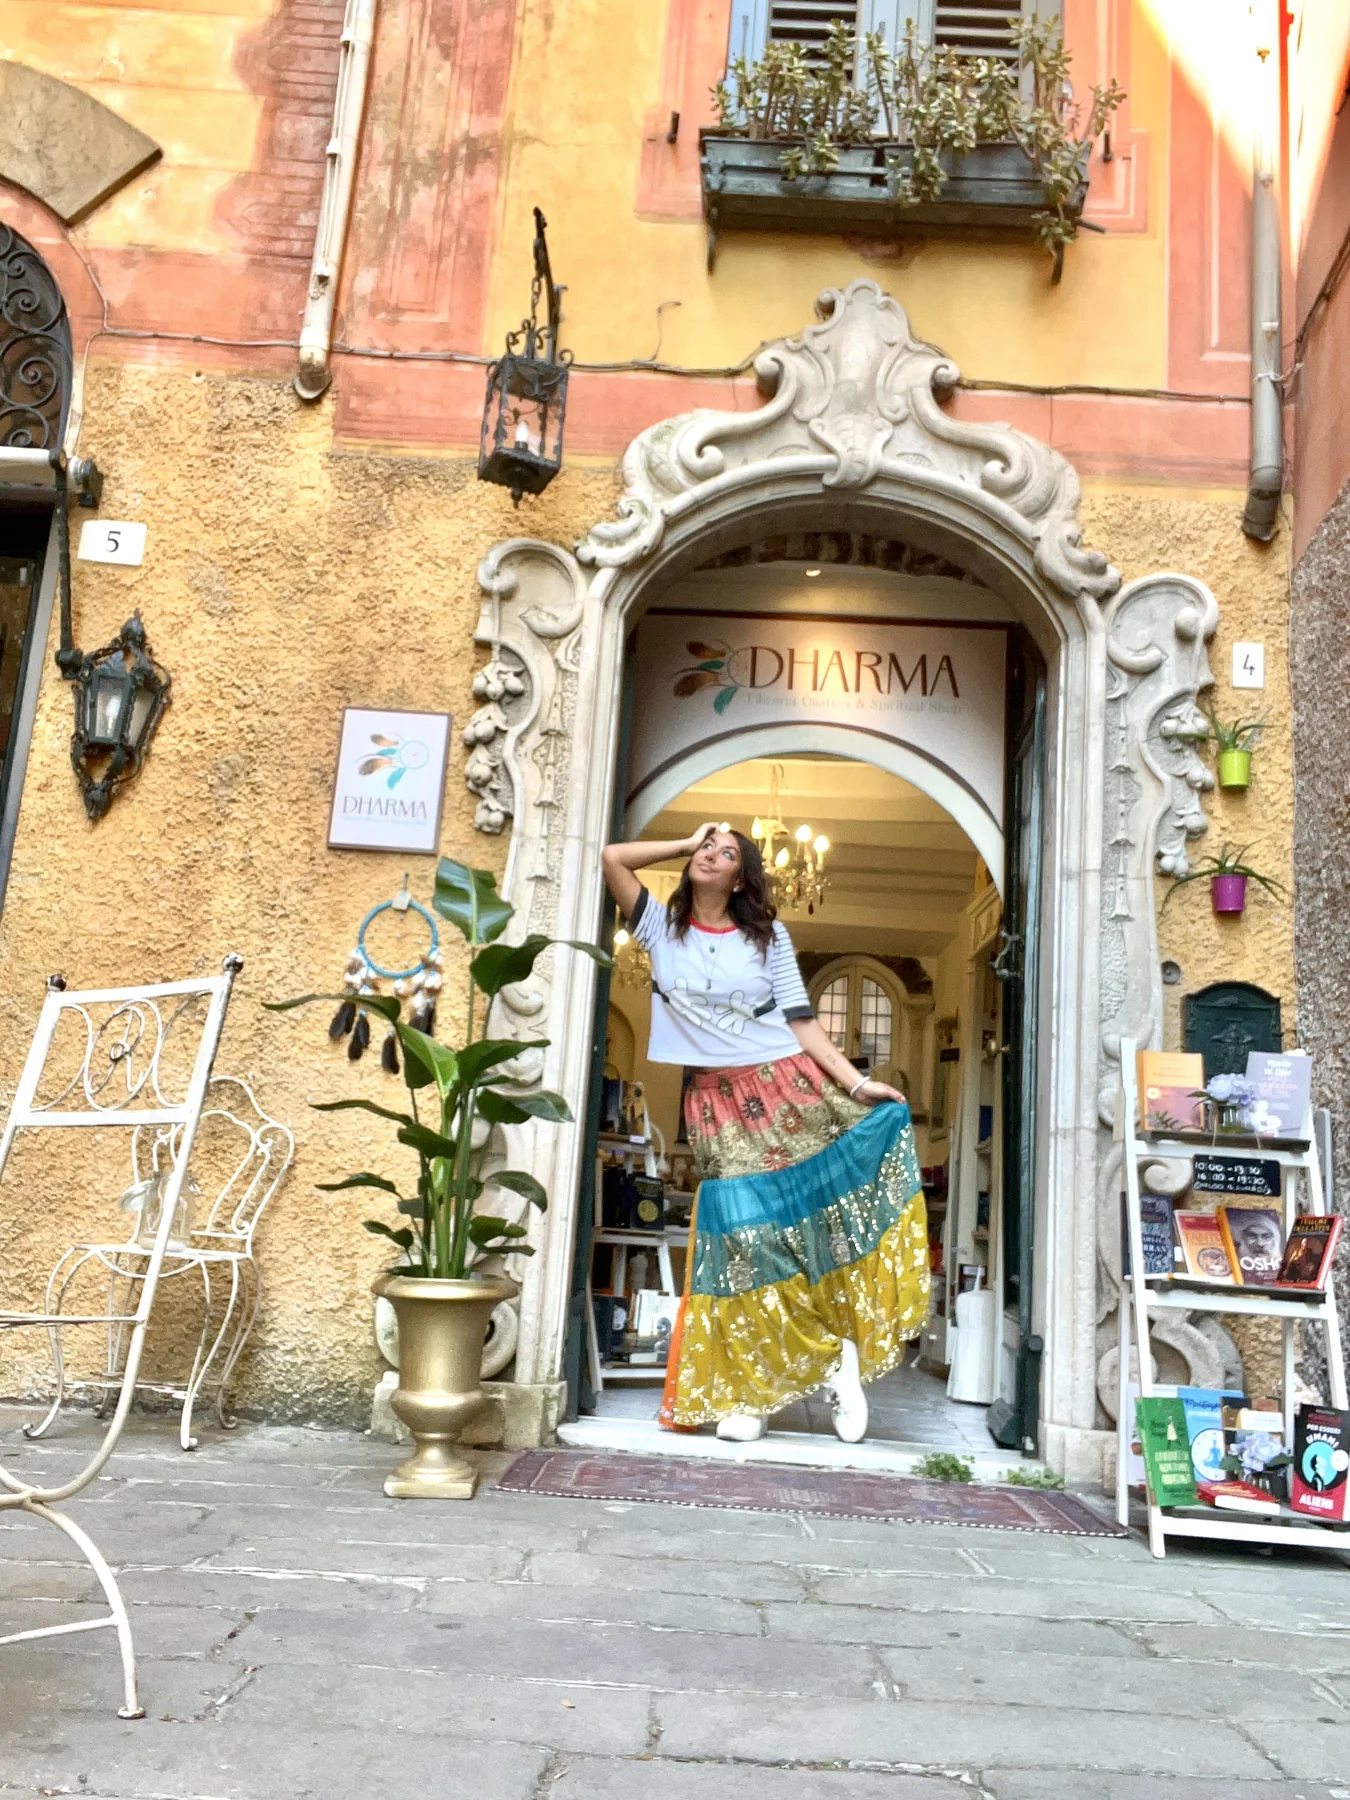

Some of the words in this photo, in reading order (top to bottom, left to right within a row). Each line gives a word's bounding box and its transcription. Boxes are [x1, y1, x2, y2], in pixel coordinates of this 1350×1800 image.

[105, 530, 121, 553] 5
[749, 645, 960, 698] DHARMA
[1242, 653, 1256, 676] 4
[343, 796, 428, 819] DHARMA
